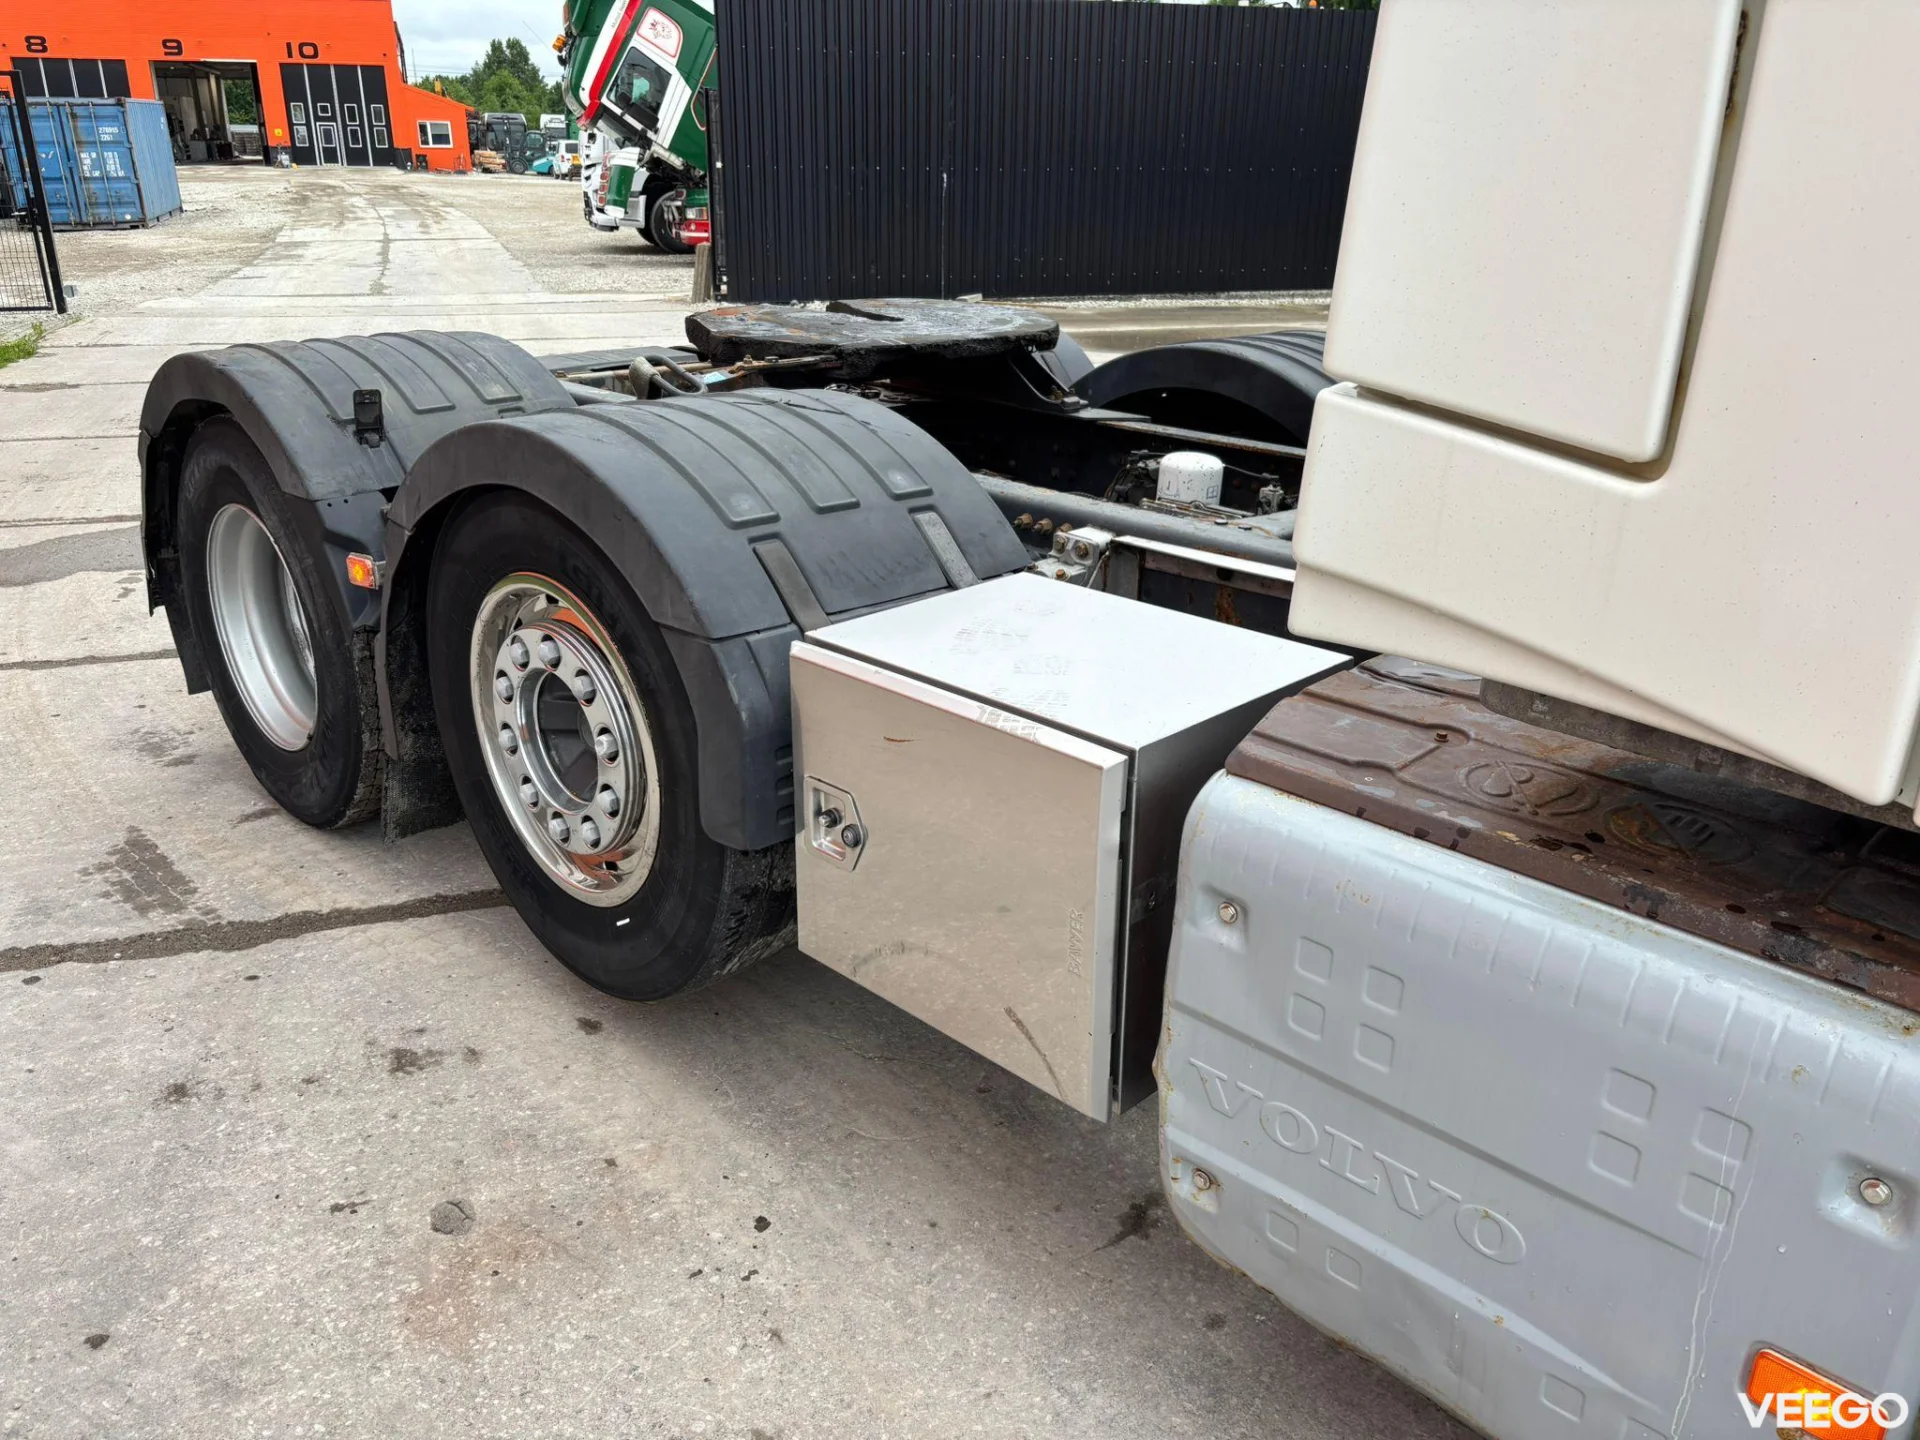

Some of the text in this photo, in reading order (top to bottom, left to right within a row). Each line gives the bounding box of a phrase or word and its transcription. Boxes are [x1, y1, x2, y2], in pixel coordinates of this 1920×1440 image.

[24, 35, 49, 54] 8
[161, 38, 184, 56] 9
[285, 41, 320, 60] 10
[1188, 1057, 1528, 1265] VOLVO
